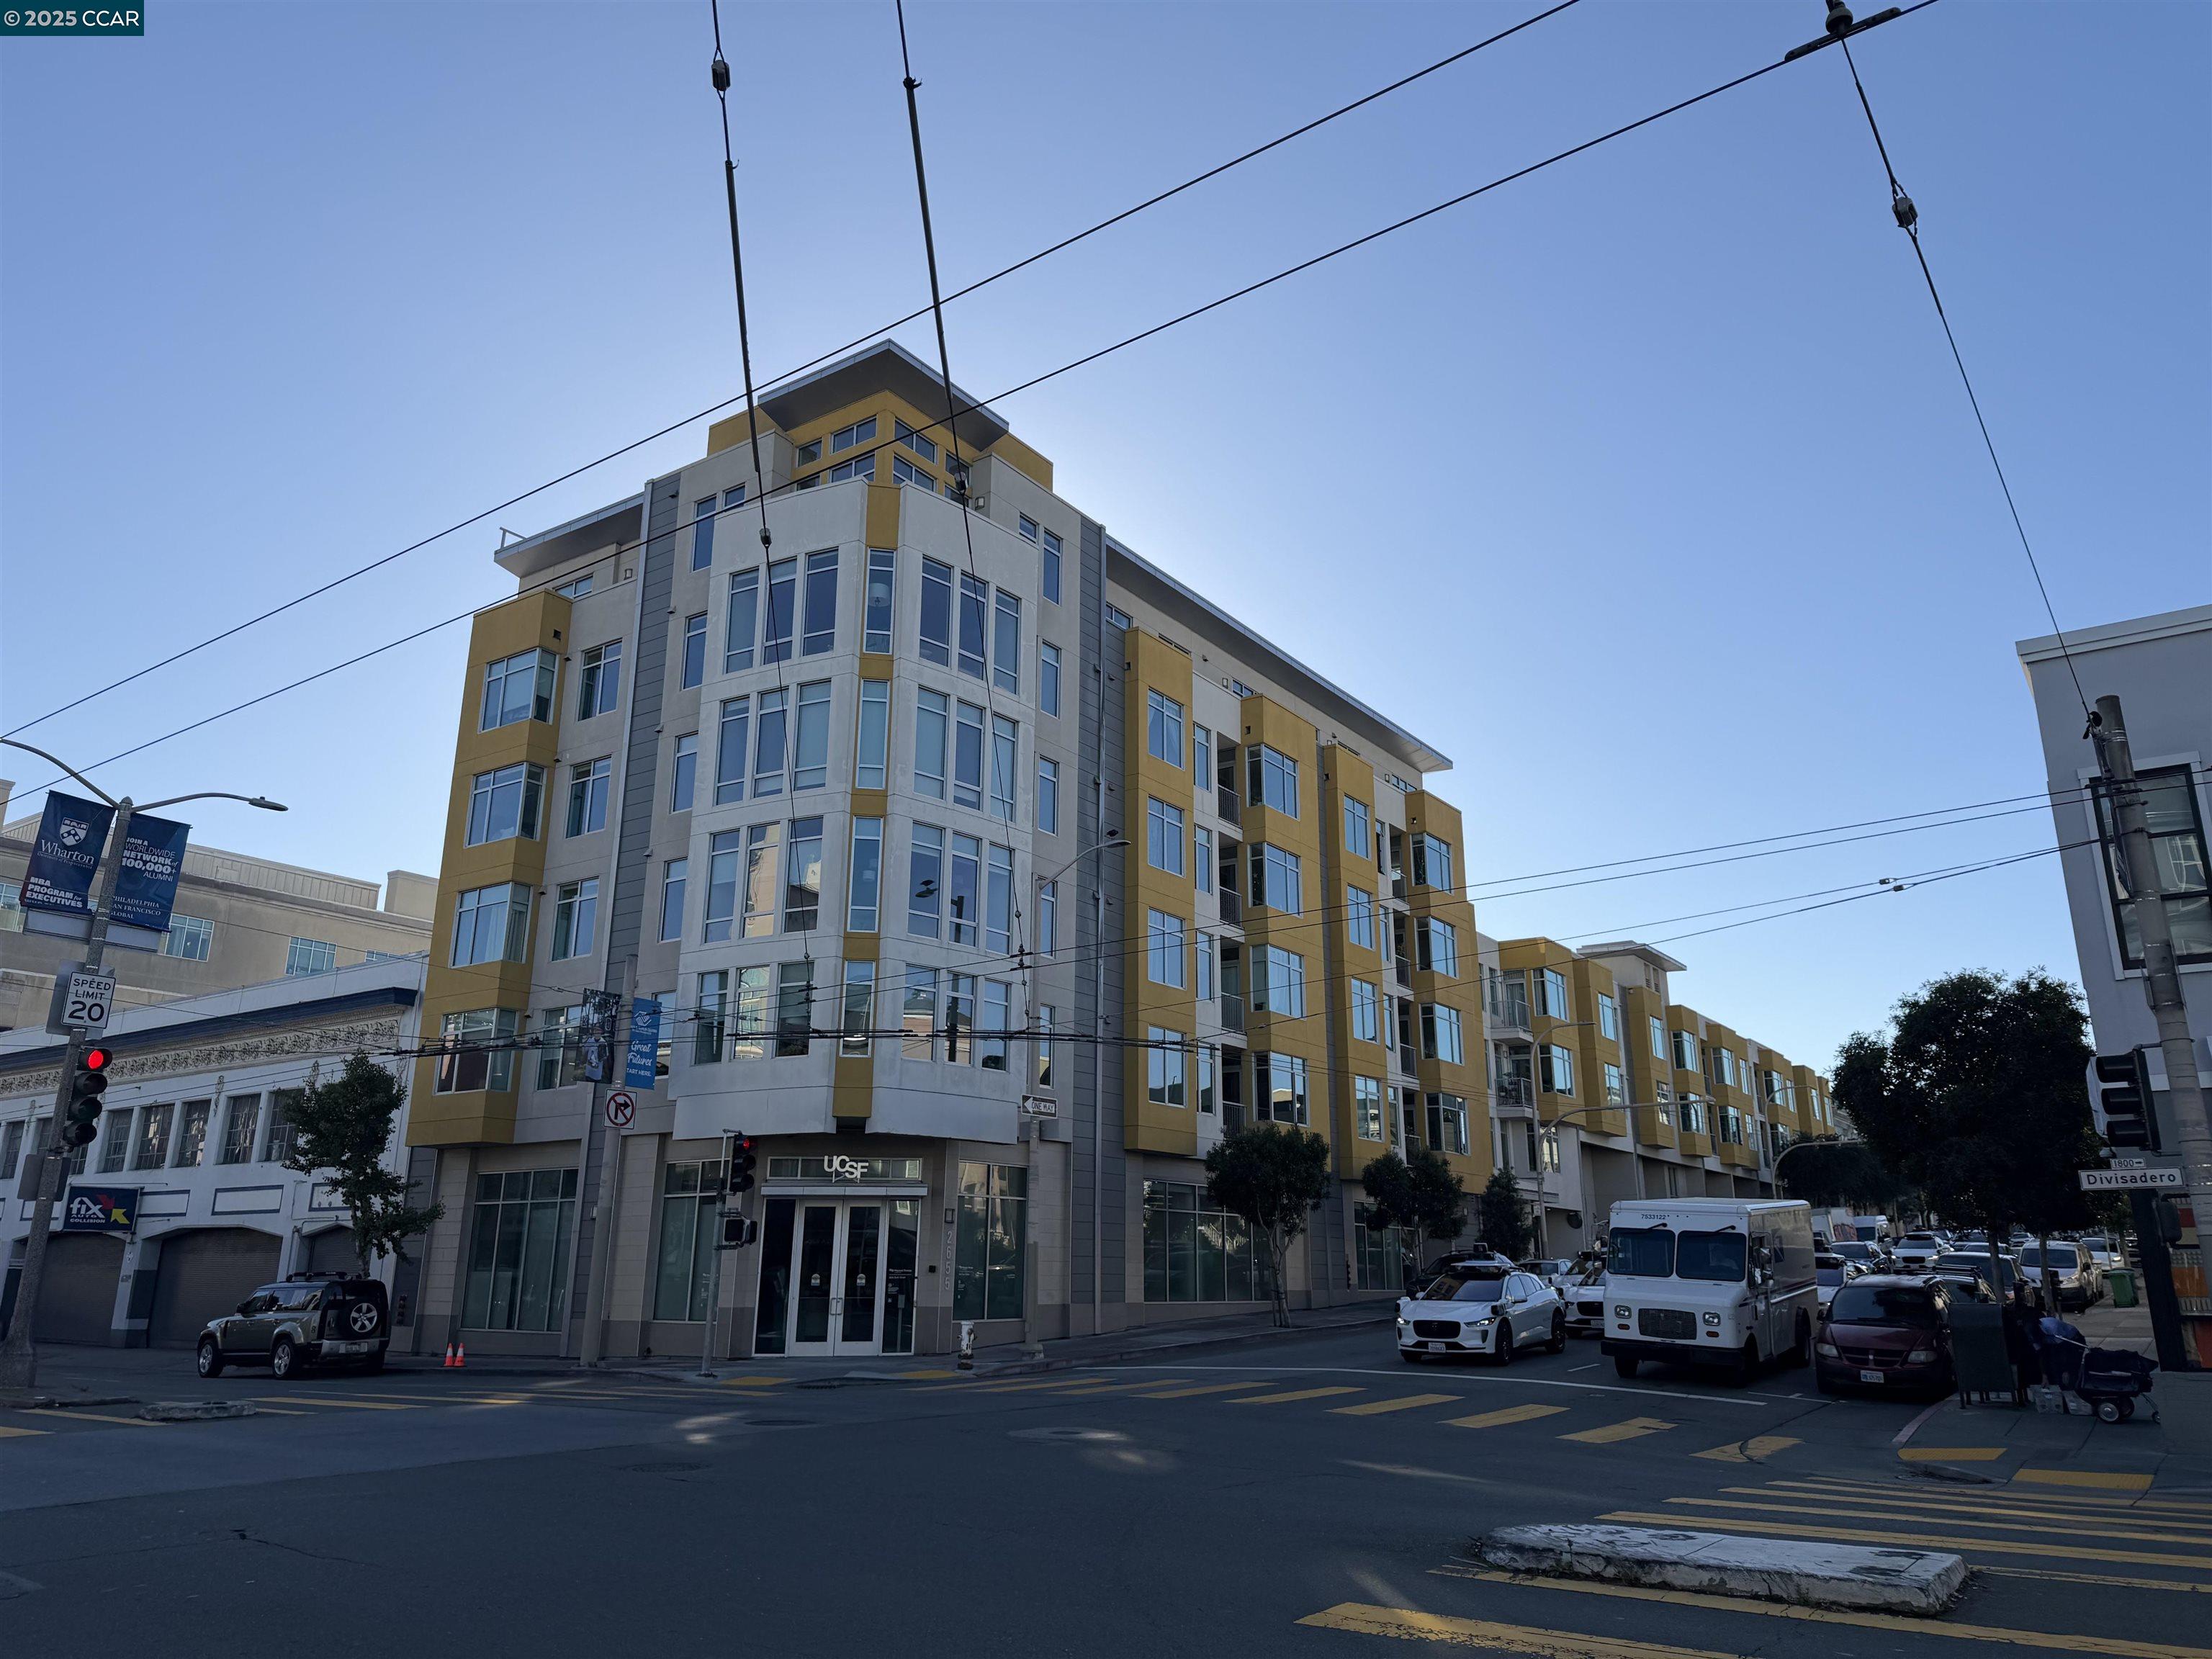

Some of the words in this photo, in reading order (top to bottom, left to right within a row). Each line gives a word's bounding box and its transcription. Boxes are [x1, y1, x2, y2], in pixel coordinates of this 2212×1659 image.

[41, 840, 94, 864] Wharton
[125, 843, 176, 858] WORLDWIDE
[123, 850, 172, 865] NETWORK
[122, 858, 176, 874] 100,000+
[30, 877, 51, 886] MBA
[143, 871, 173, 882] ALUMNI
[28, 884, 73, 899] PROGRAM
[26, 891, 83, 907] EXECUTIVES
[113, 896, 159, 908] HILADELPHIA
[124, 905, 161, 916] FRANCISCO
[73, 979, 111, 991] SPEED
[75, 989, 105, 1000] LIMIT
[68, 1000, 104, 1022] 20
[631, 1040, 652, 1052] Great
[627, 1052, 652, 1066] Futures
[1032, 1101, 1042, 1110] ONE
[1043, 1102, 1054, 1112] WAY
[824, 1155, 868, 1178] UCSF
[2087, 1172, 2176, 1185] Divisadero
